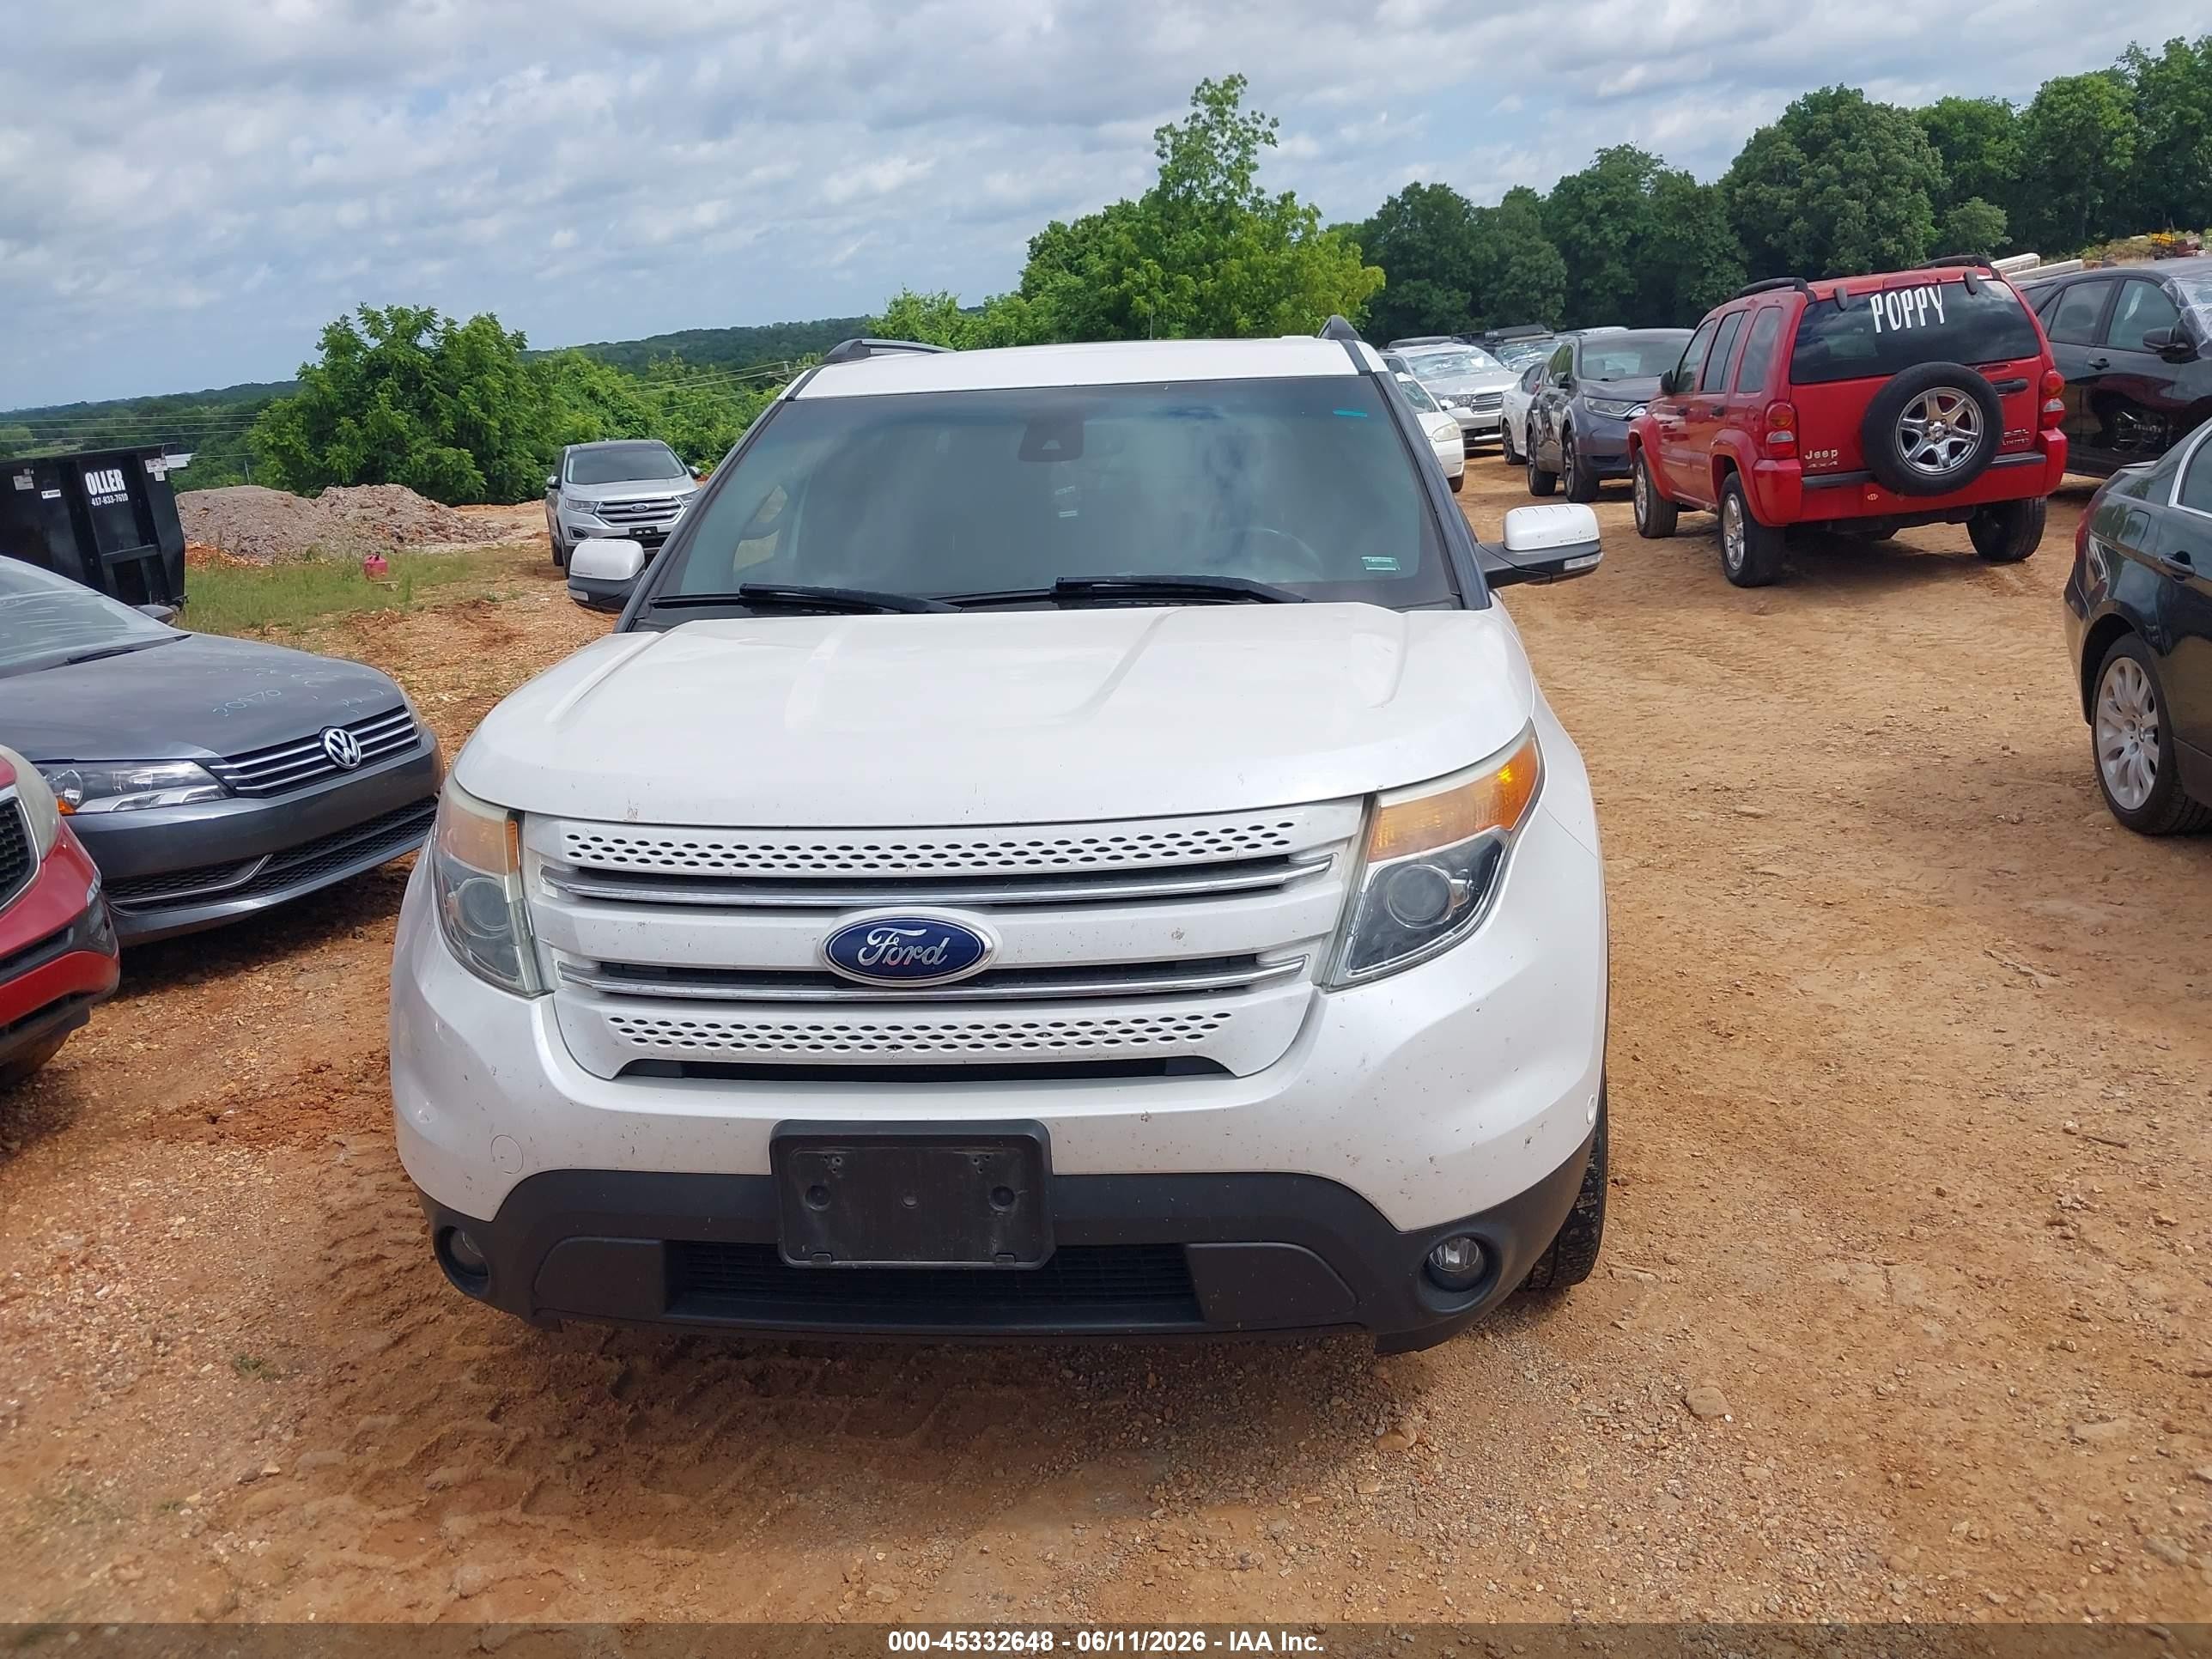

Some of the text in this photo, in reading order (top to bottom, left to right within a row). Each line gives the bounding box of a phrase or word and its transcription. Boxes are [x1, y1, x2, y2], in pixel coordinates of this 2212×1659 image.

[1869, 284, 1945, 333] POPPY
[1805, 449, 1838, 459] Jeep
[85, 469, 126, 495] OLLER
[858, 927, 951, 966] Ford
